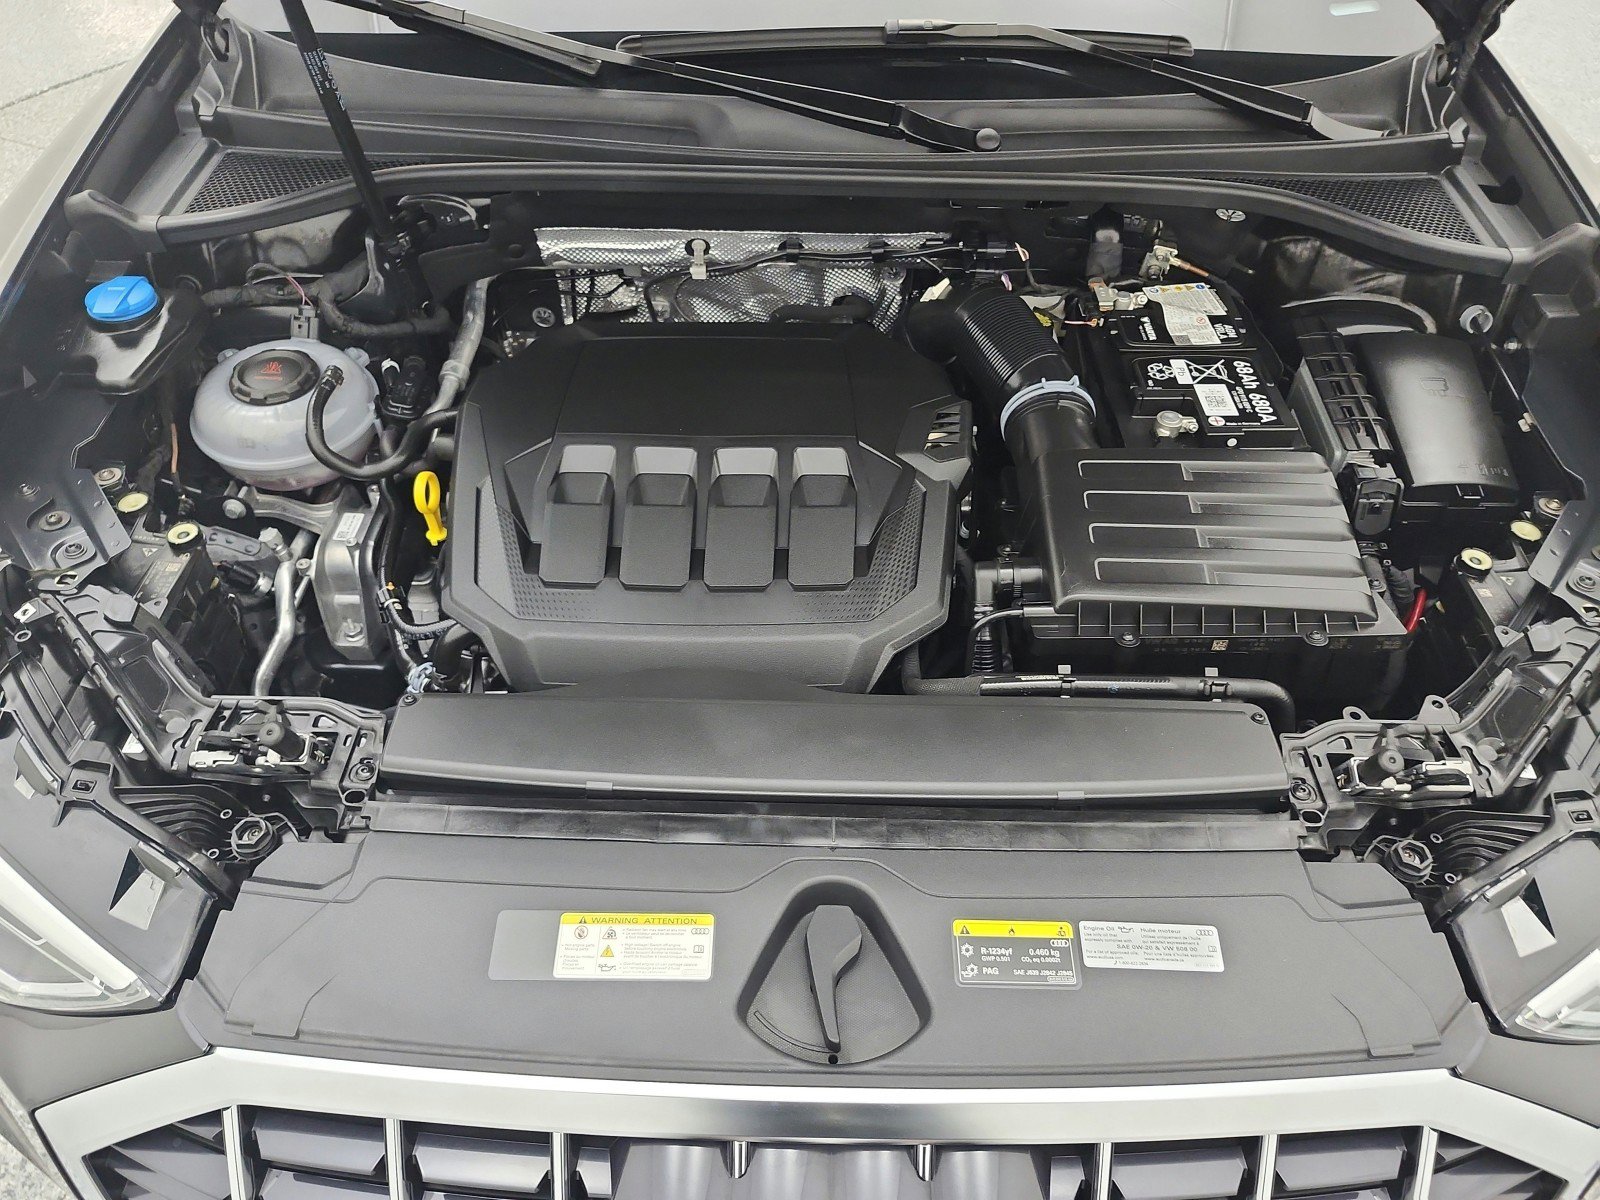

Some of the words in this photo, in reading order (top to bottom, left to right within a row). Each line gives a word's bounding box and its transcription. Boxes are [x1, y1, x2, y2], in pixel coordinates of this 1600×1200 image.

[1213, 323, 1228, 340] VRLA
[1223, 324, 1238, 338] AGM
[1176, 367, 1186, 377] Pb
[1233, 360, 1260, 389] 68Ah
[1248, 393, 1278, 423] 680A
[643, 917, 698, 925] ATTENTION
[980, 946, 1013, 956] R-1234yf
[1050, 948, 1060, 957] kg
[982, 967, 1000, 975] PAG
